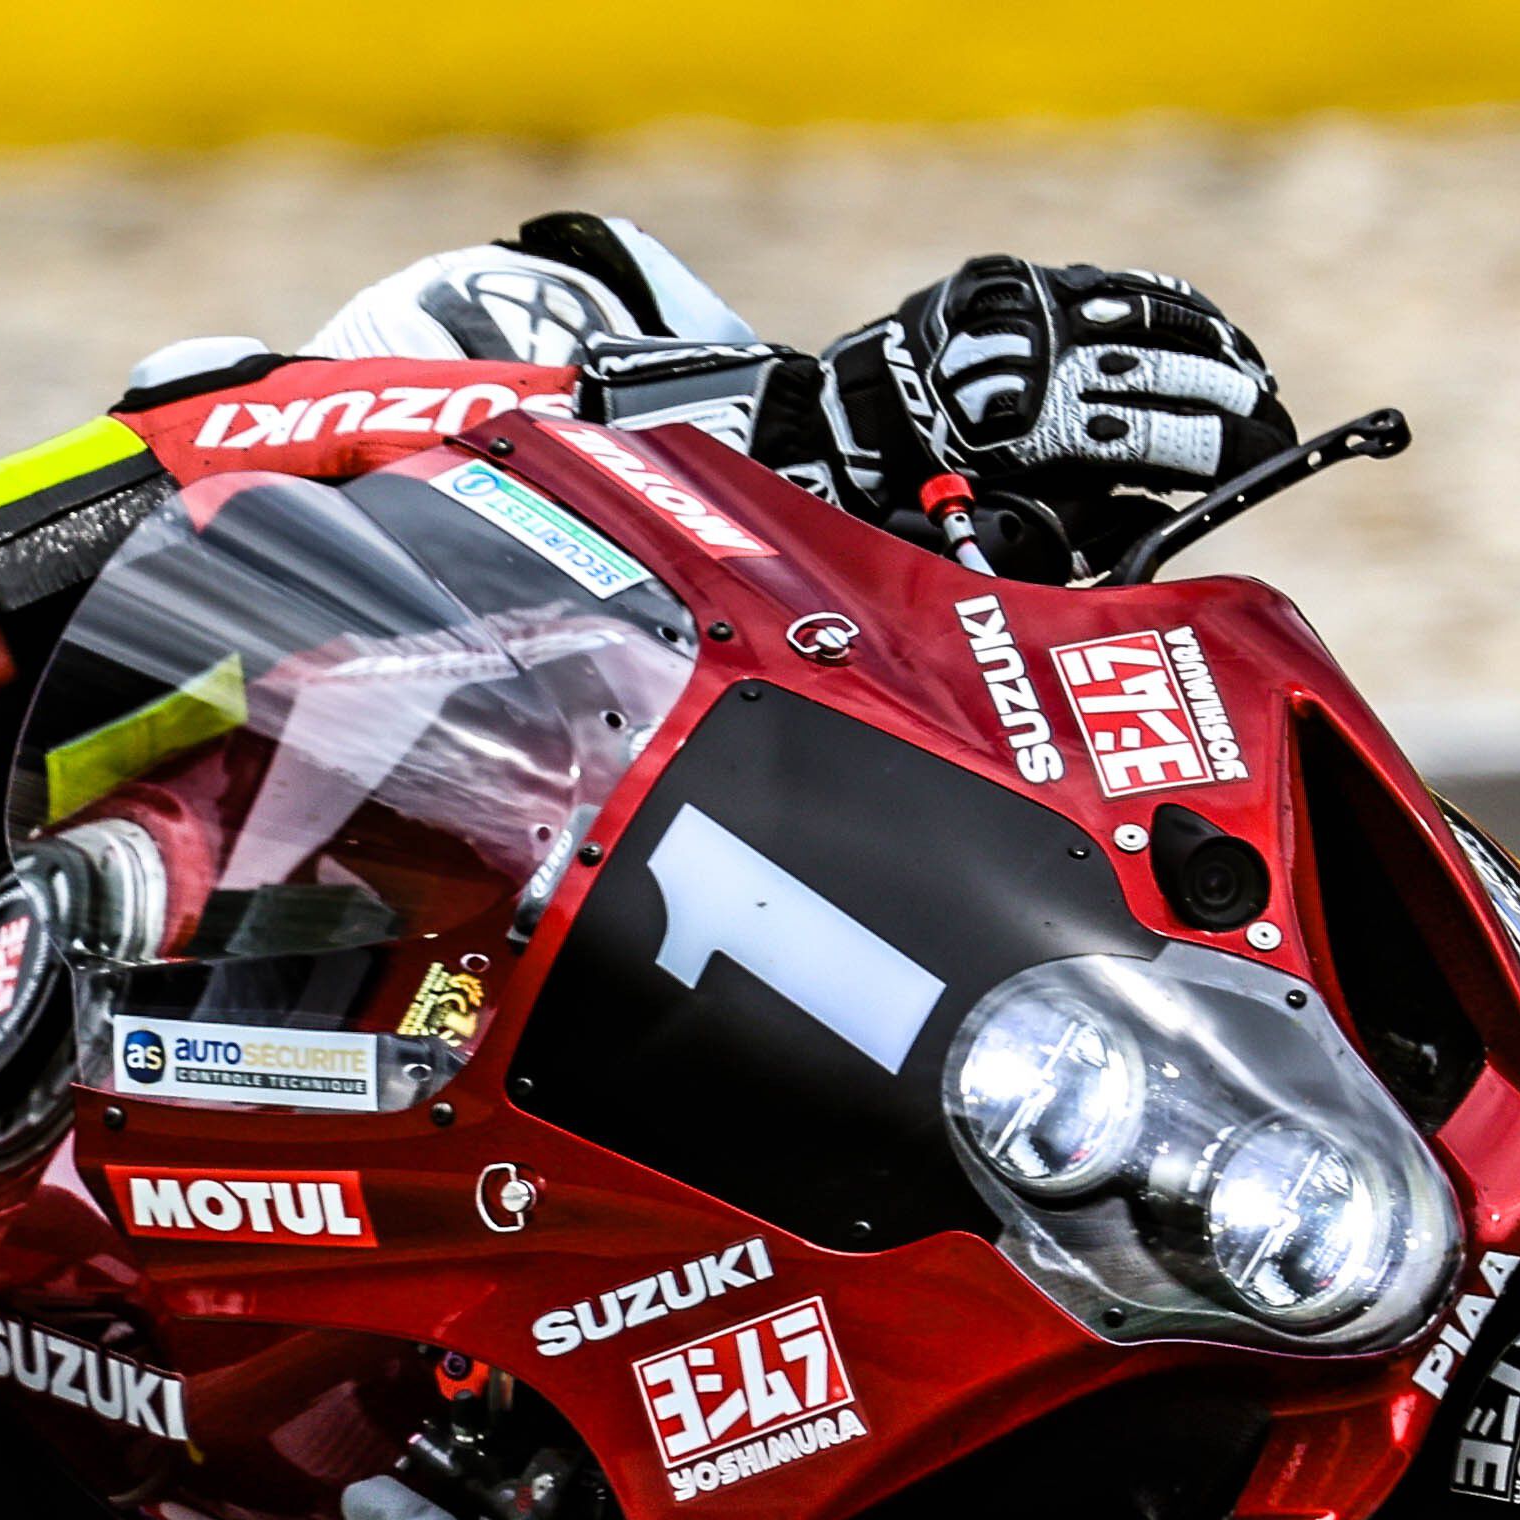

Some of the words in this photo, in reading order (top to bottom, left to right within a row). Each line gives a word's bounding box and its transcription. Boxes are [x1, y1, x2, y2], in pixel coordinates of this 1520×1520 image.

[555, 427, 765, 551] MOTUL
[954, 594, 1065, 784] SUZUKI
[1164, 625, 1250, 782] YOSHIMURA
[646, 802, 948, 1076] 1
[129, 1176, 362, 1237] MOTUL
[531, 1237, 775, 1357] SUZUKI
[666, 1408, 868, 1502] YOSHIMURA
